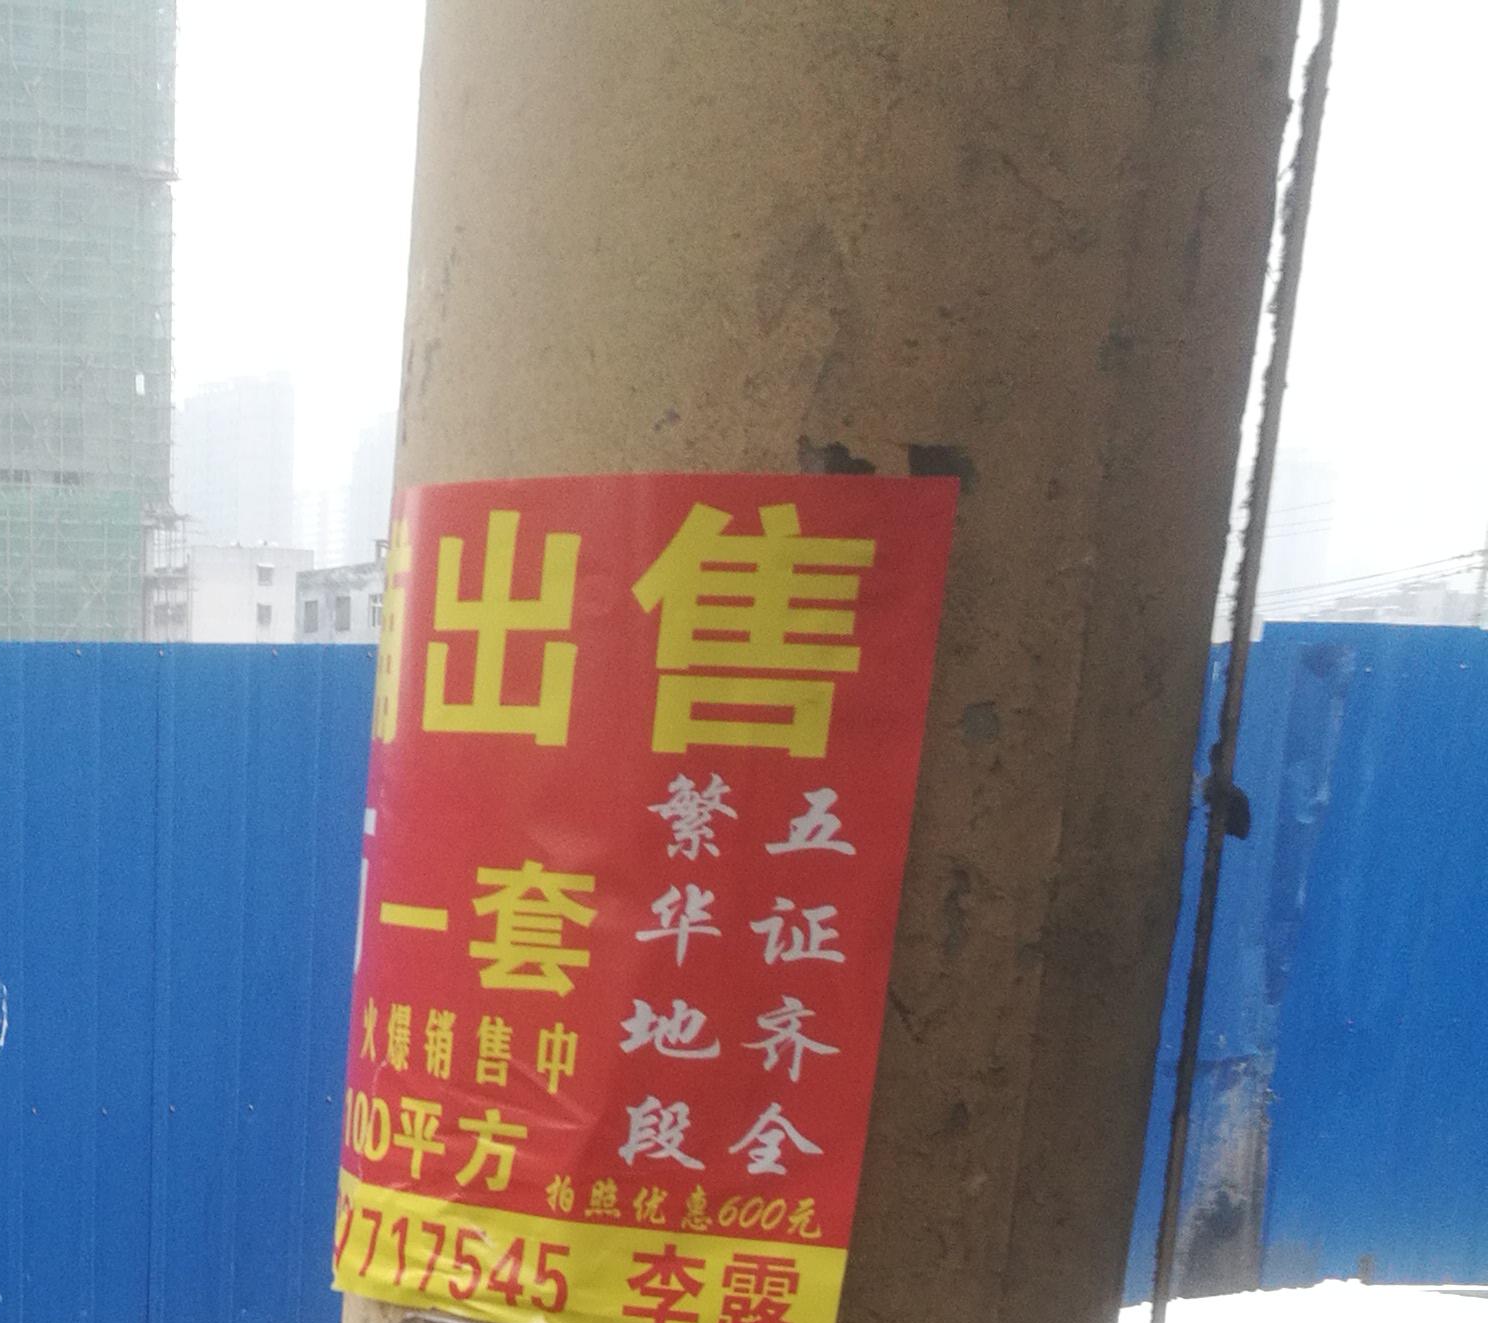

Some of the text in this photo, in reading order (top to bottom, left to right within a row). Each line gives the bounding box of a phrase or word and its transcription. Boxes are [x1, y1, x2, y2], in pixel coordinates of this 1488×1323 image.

[359, 996, 580, 1095] 火爆销售中
[617, 773, 739, 1171] 繁华地段
[728, 787, 857, 1176] 五证齐全
[544, 1173, 823, 1242] 拍照优惠600元
